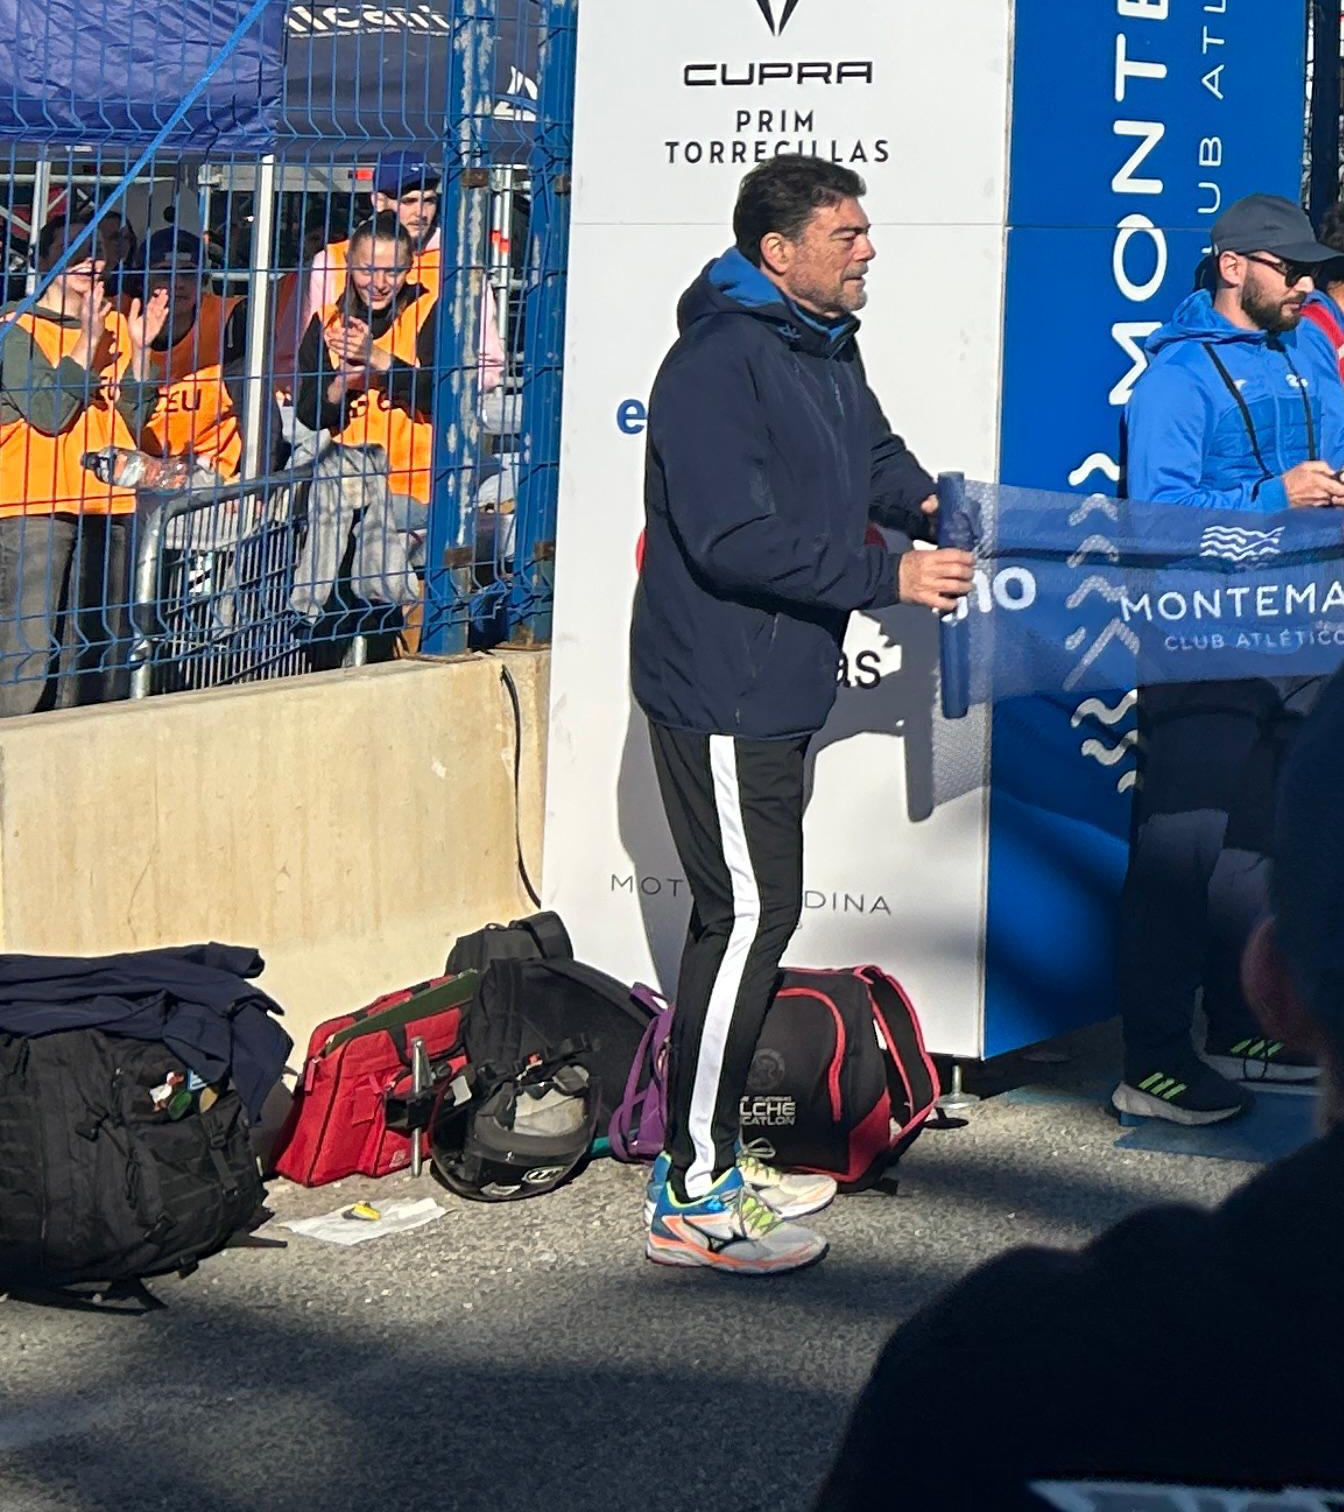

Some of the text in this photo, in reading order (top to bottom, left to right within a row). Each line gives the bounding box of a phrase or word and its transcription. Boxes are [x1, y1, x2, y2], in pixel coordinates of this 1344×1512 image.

[683, 61, 874, 87] CUPRA
[736, 109, 814, 133] PRIM
[1165, 633, 1235, 652] CLUB
[739, 1101, 796, 1116] LCHE
